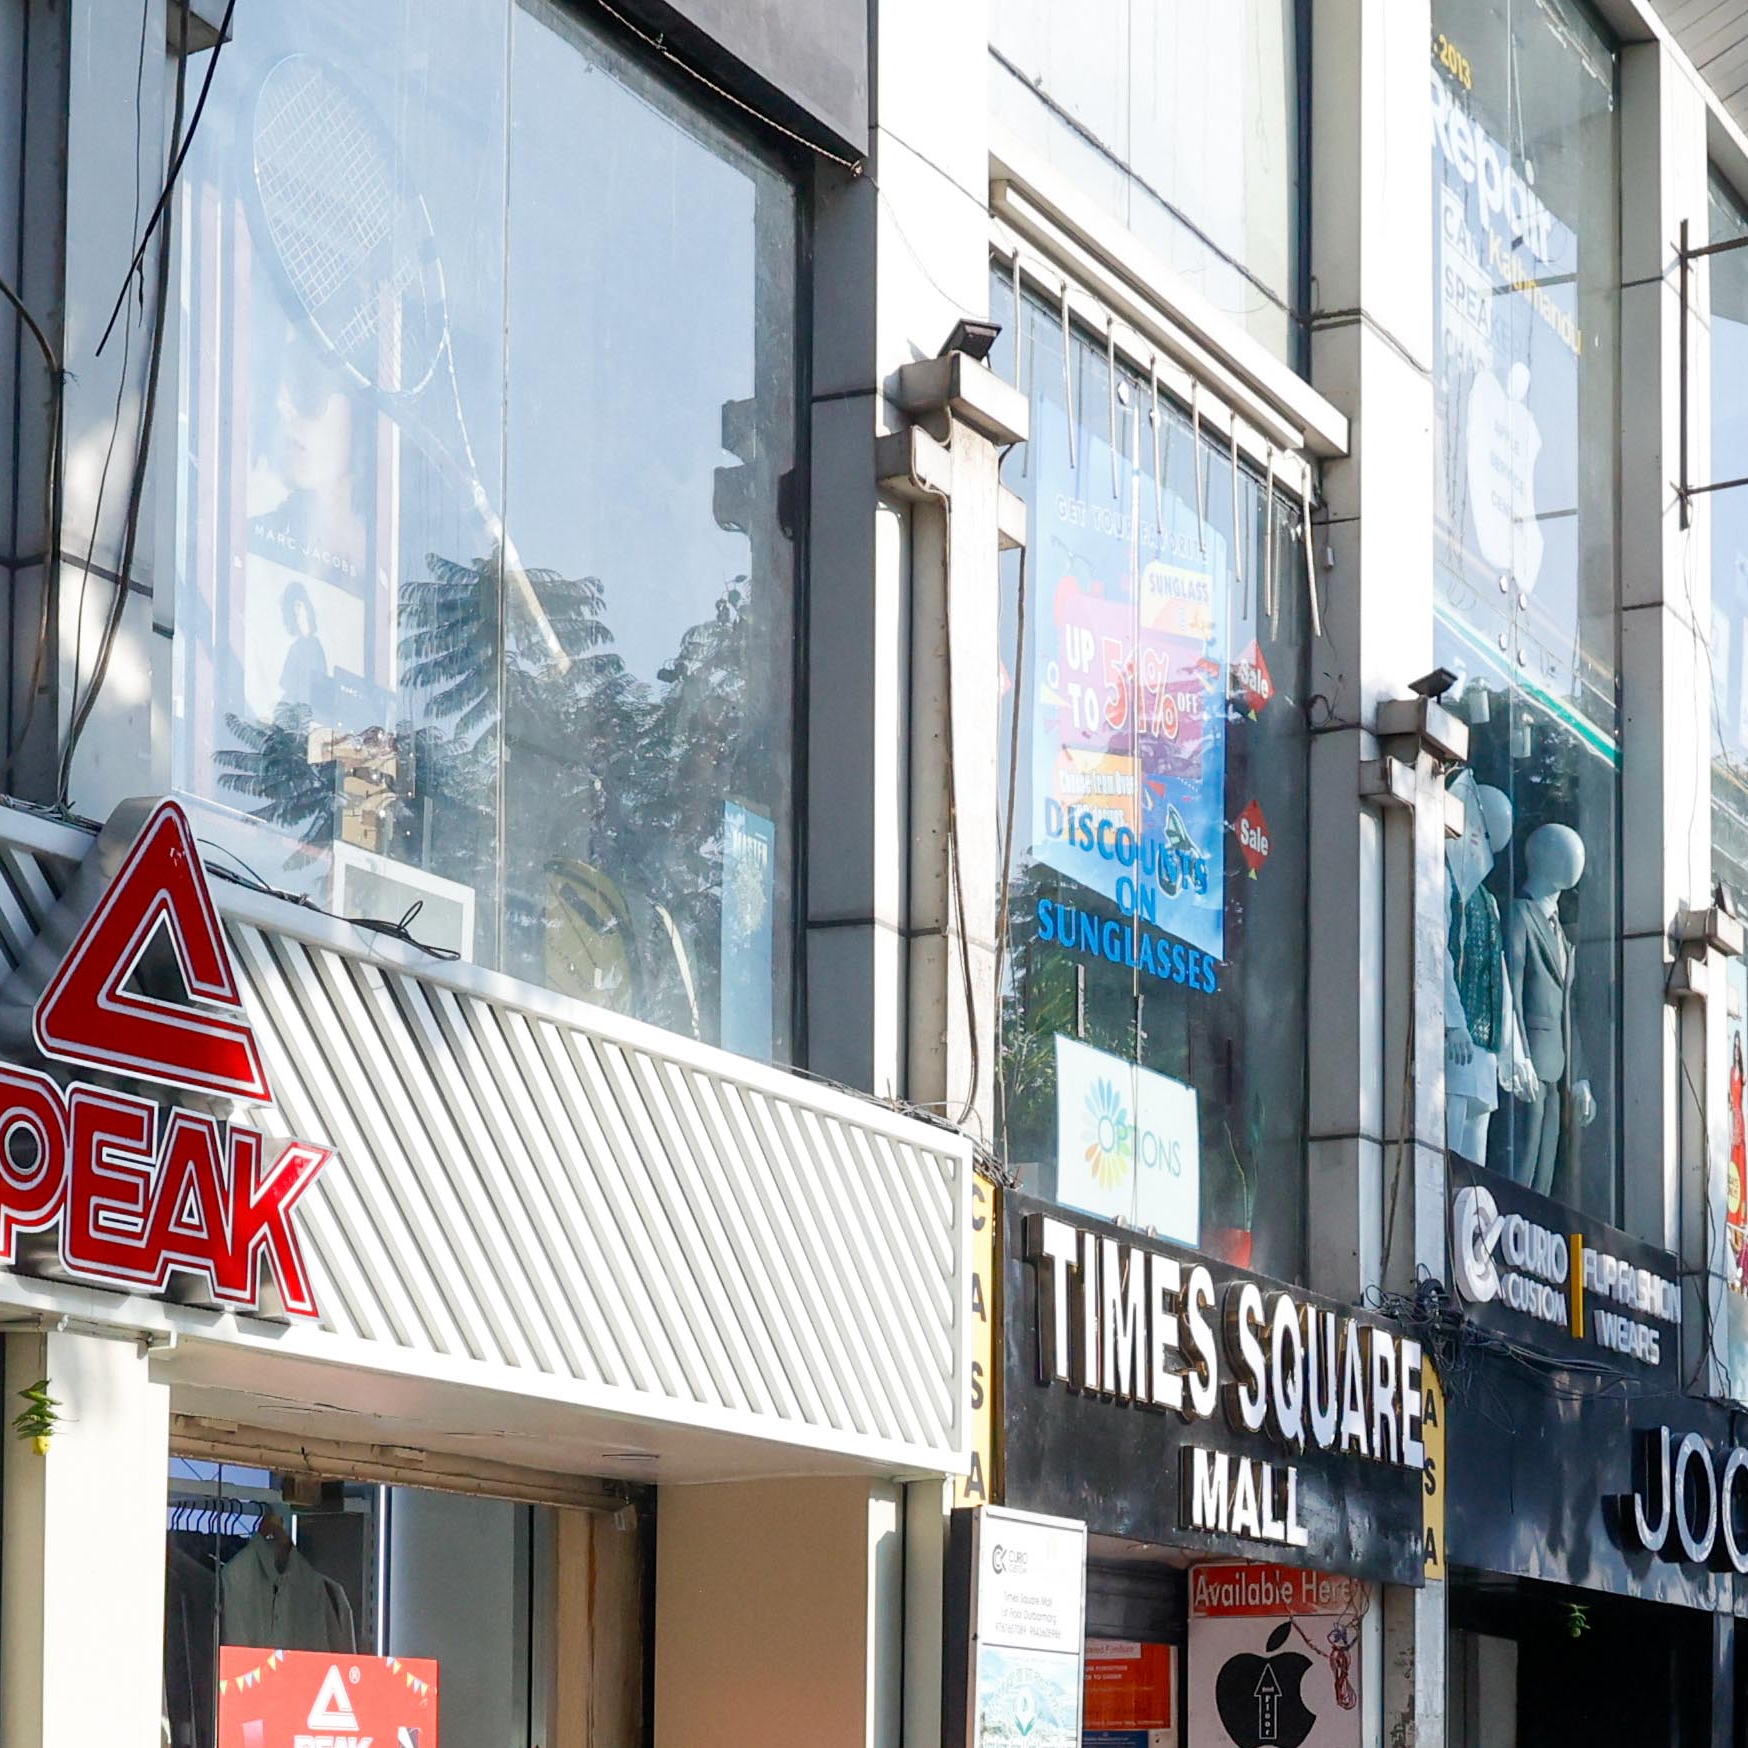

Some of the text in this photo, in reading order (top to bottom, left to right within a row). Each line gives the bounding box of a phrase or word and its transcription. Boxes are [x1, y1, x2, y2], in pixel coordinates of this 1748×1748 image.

[254, 523, 356, 577] MARC JACOBS
[1149, 572, 1210, 603] SUNGLASS
[1065, 624, 1095, 673] UP
[1177, 692, 1200, 714] OFF
[1241, 658, 1269, 700] Sale
[1067, 683, 1100, 732] TO
[1044, 797, 1208, 895] DISCOUNTS
[1241, 818, 1269, 856] Sale
[1115, 876, 1156, 926] ON
[1037, 899, 1218, 995] SUNGLASSES
[1097, 1114, 1182, 1179] OPTIONS
[1501, 1213, 1569, 1284] CURIO
[1502, 1272, 1568, 1327] CUSTOM
[1029, 1214, 1424, 1470] TIMES SQUARE
[1594, 1309, 1660, 1366] WEARS
[1187, 1446, 1308, 1547] MALL
[1194, 1571, 1352, 1608] Available Here
